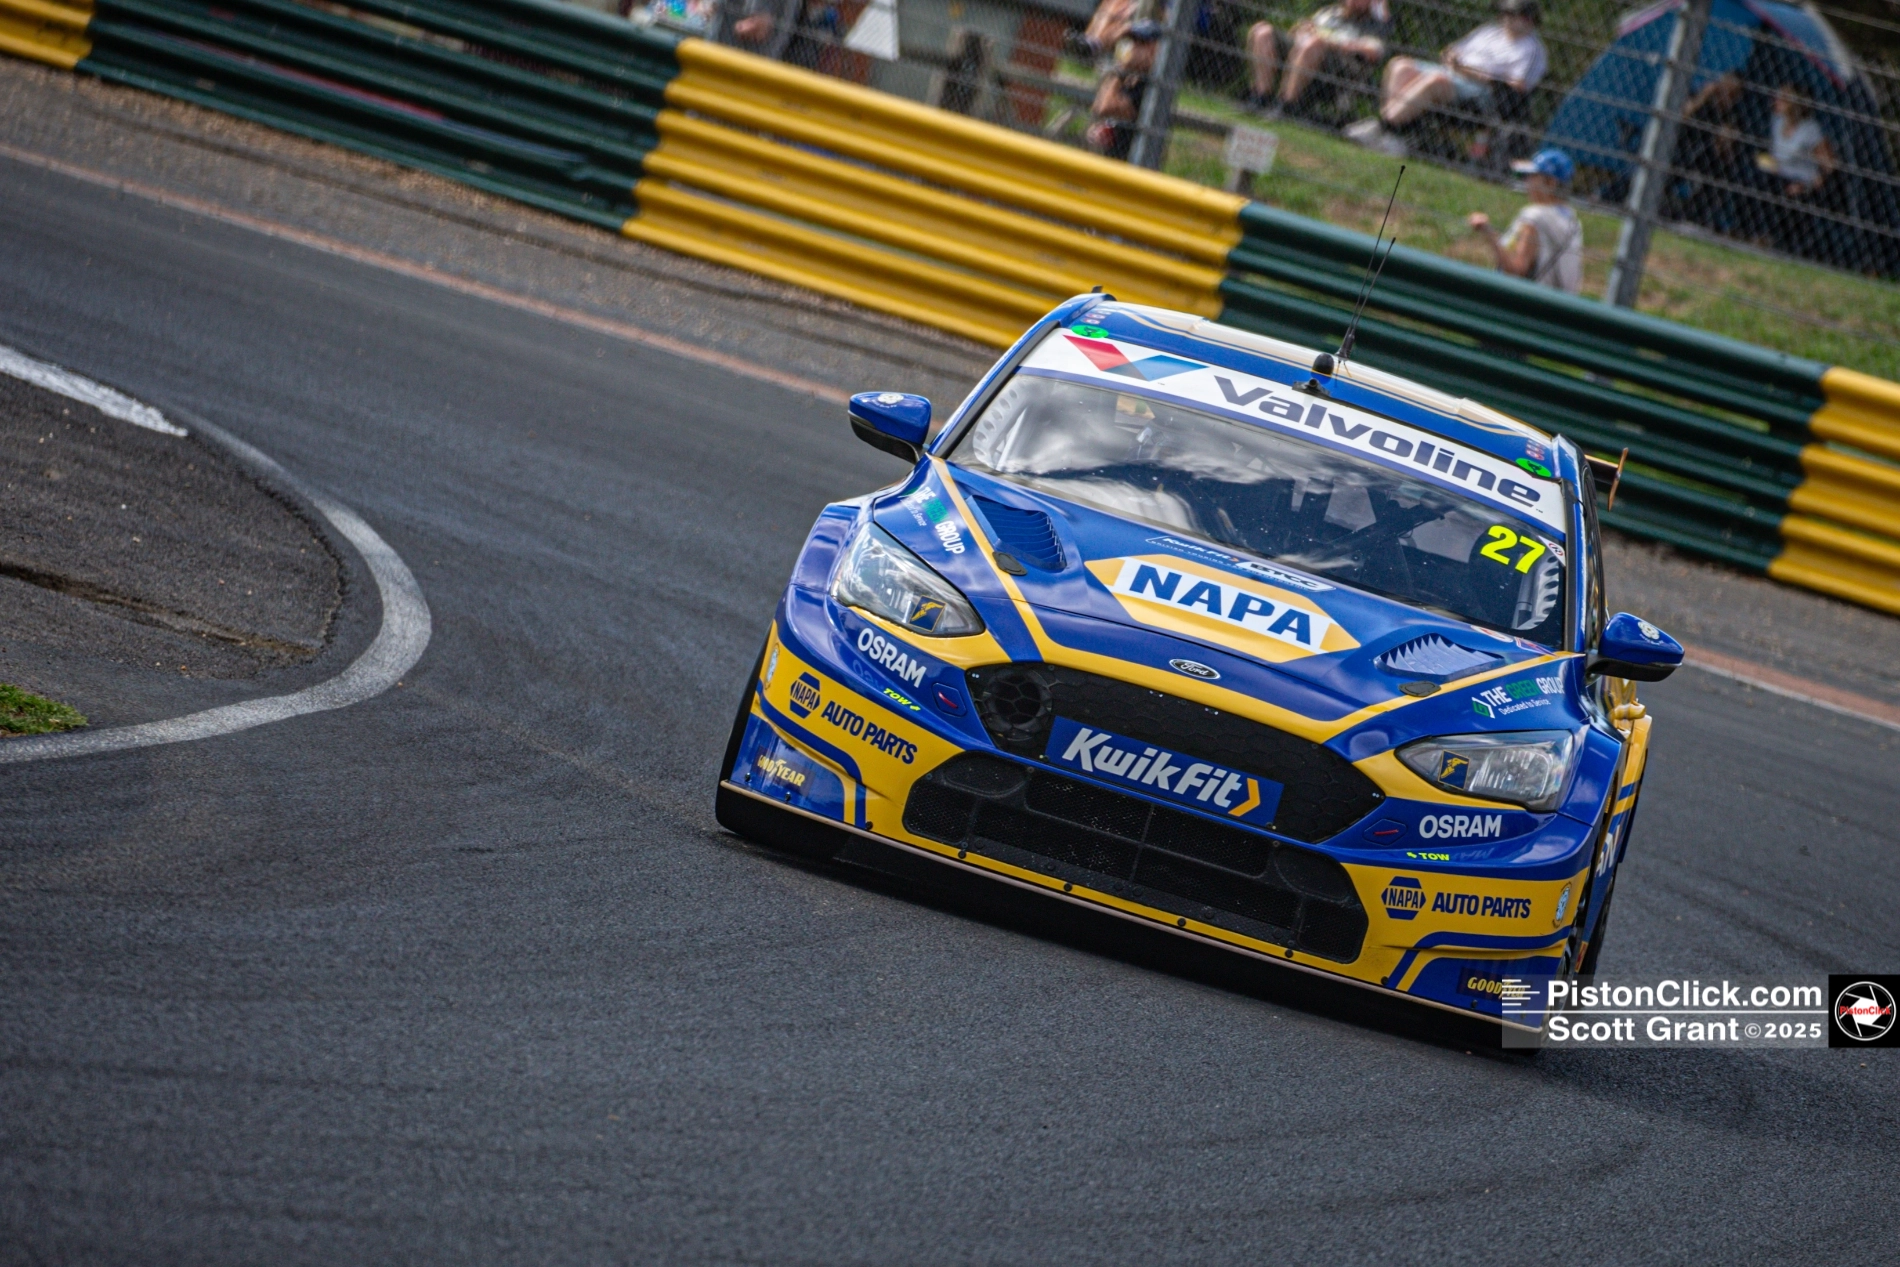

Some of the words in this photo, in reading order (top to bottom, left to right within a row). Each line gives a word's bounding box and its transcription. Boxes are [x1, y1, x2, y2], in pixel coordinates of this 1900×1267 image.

[1213, 375, 1541, 508] Valvoline
[934, 520, 966, 554] GROUP
[1480, 525, 1546, 574] 27
[1129, 564, 1311, 645] NAPA
[858, 628, 927, 688] OSRAM
[1180, 662, 1209, 676] Ford
[792, 681, 817, 711] NAPA
[883, 687, 912, 705] TOW
[1480, 686, 1512, 707] THE
[1505, 679, 1541, 699] GREEN
[821, 700, 865, 737] AUTO
[861, 722, 918, 765] PARTS
[1419, 814, 1502, 839] OSRAM
[1418, 852, 1450, 861] TOW
[1388, 888, 1421, 909] NAPA
[1431, 892, 1480, 916] AUTO
[1481, 896, 1532, 919] PARTS
